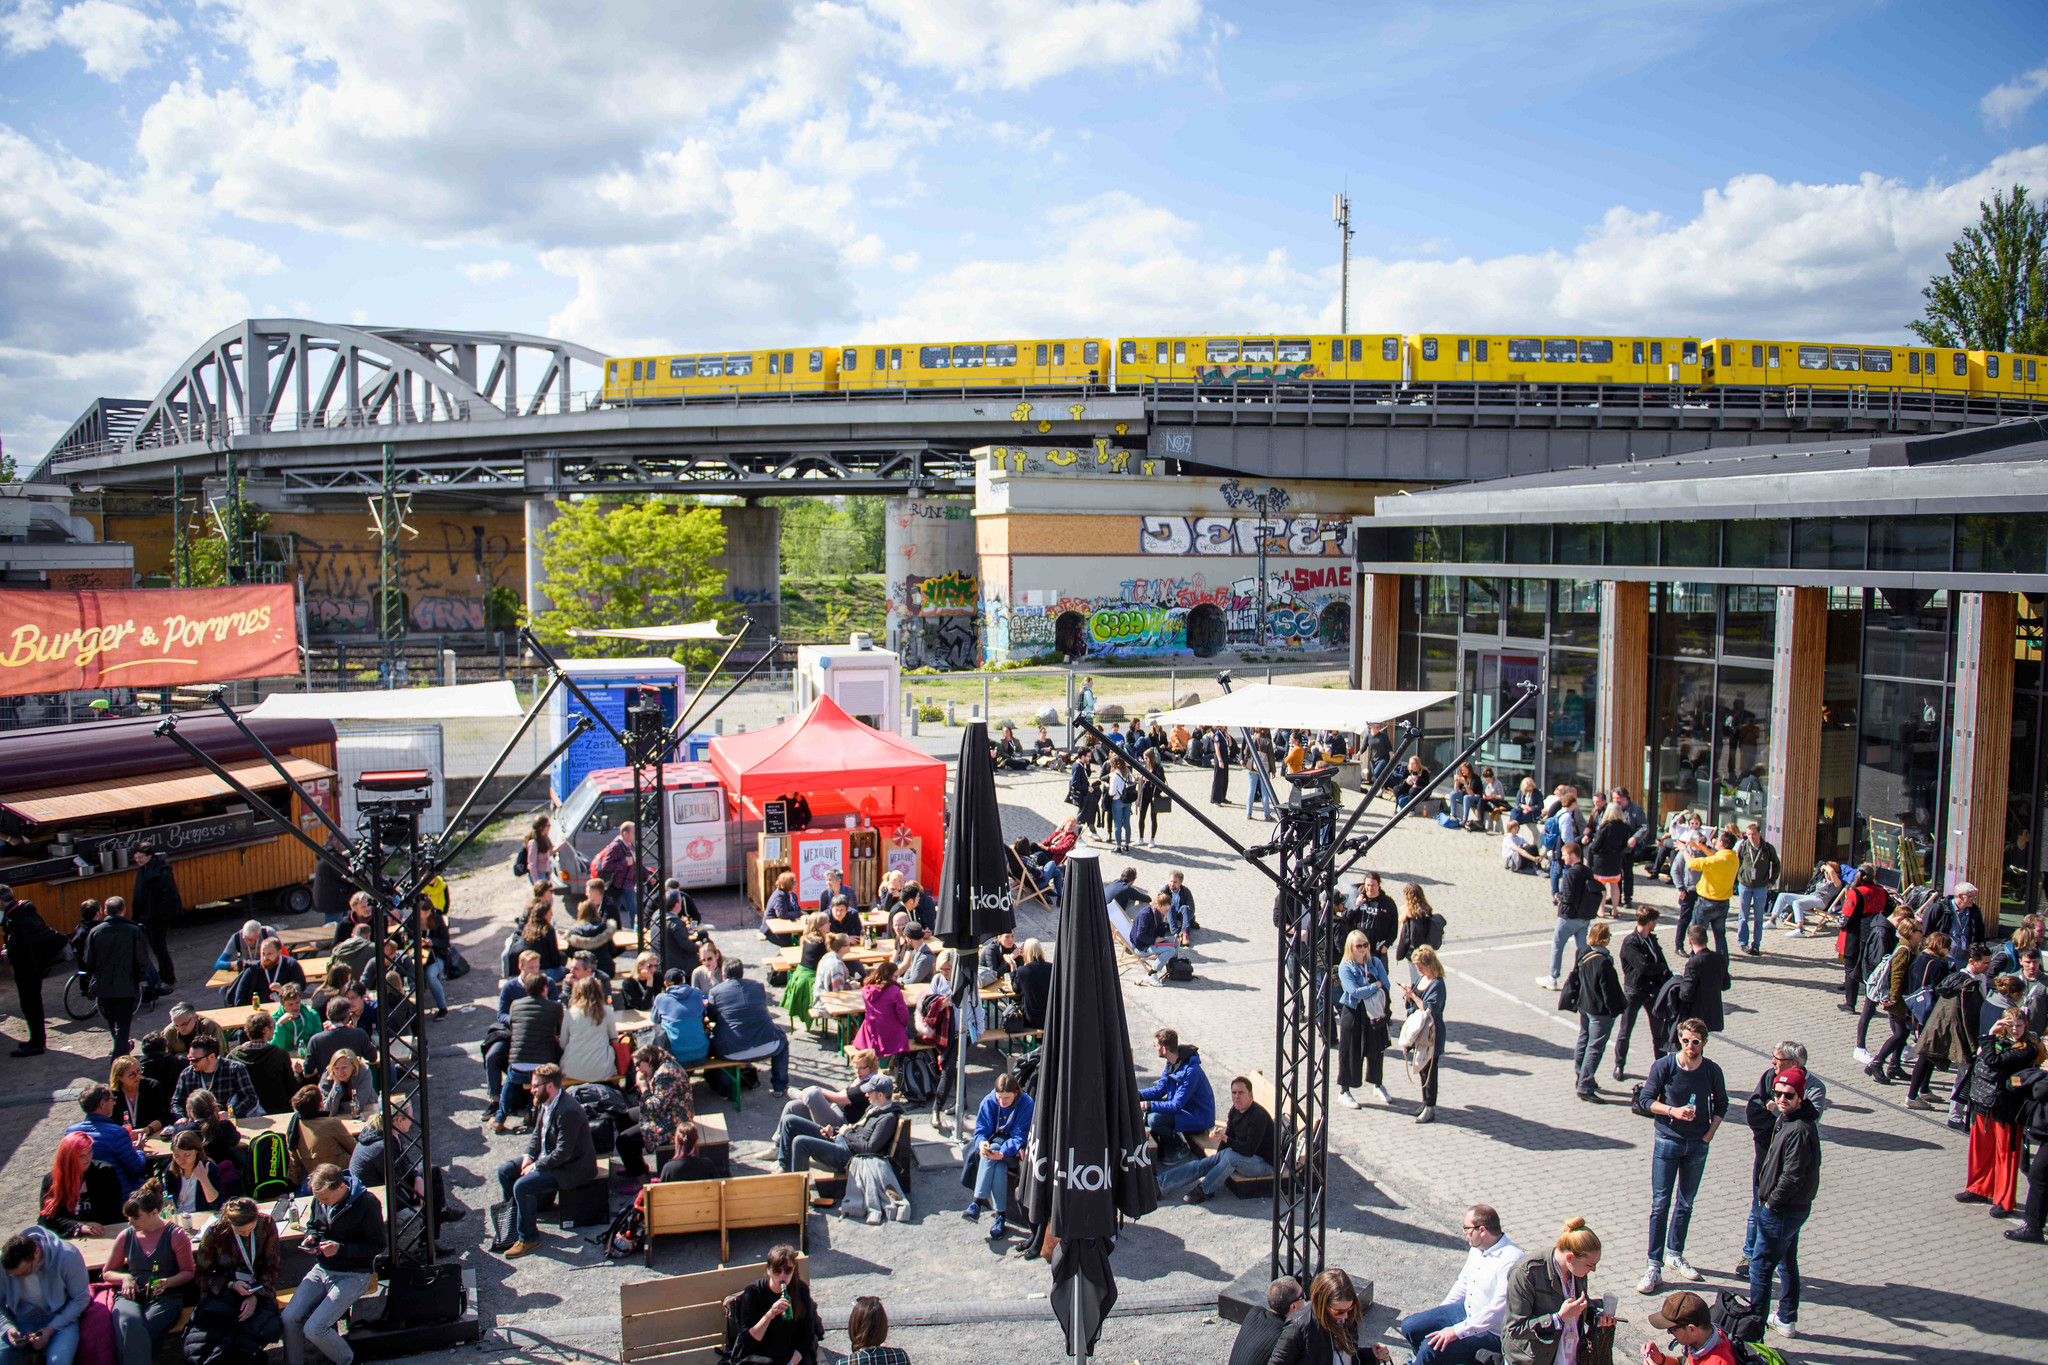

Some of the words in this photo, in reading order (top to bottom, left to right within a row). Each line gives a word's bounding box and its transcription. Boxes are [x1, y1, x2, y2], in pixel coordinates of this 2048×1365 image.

[0, 623, 136, 667] Burger
[140, 626, 159, 647] &
[163, 605, 271, 653] Pommes
[585, 740, 618, 750] Zaste
[677, 803, 717, 822] MEXILOVE
[803, 846, 838, 864] MEXILOVE
